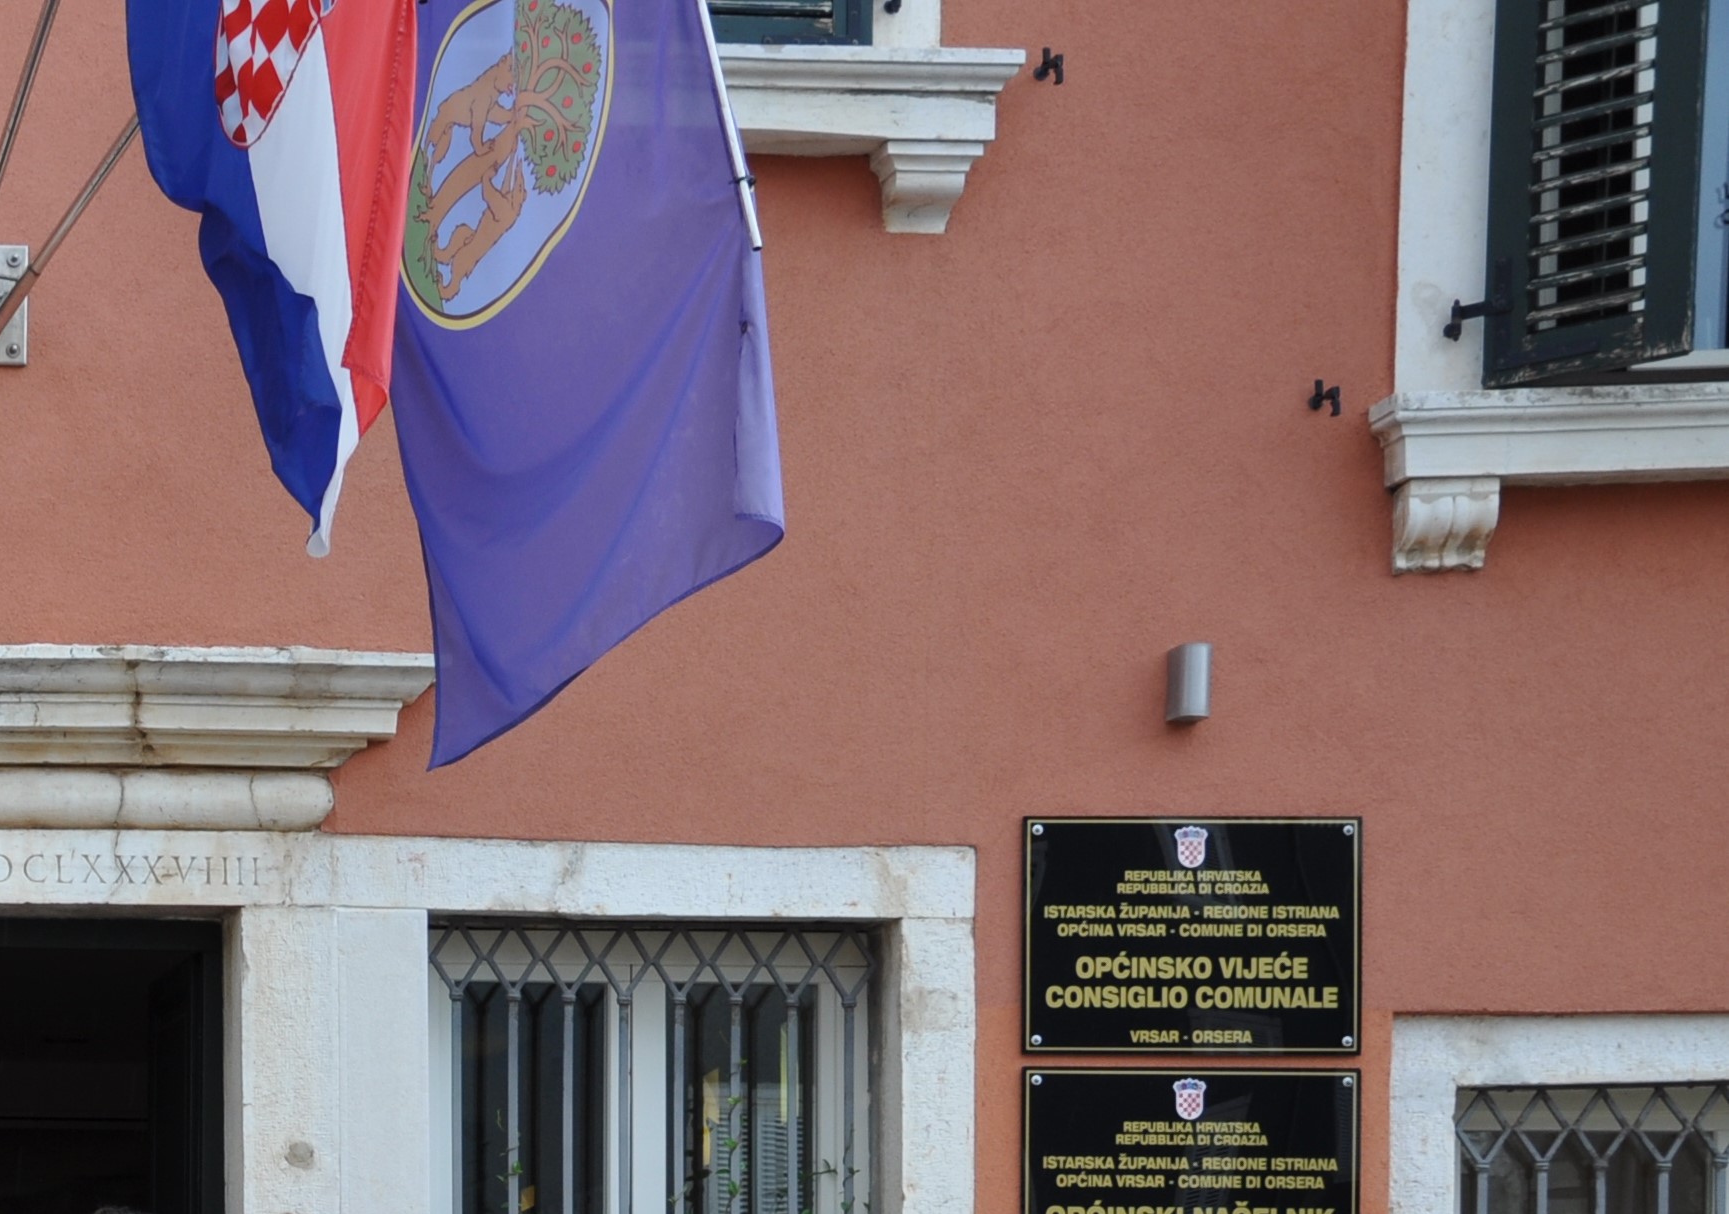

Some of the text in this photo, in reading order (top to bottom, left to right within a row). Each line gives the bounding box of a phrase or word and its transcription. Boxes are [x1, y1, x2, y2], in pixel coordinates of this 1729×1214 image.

[1125, 870, 1262, 882] REPUBLIKA HRVATSKA
[1117, 883, 1269, 895] REPUBBLICA DI CROAZIA
[1044, 905, 1116, 919] ISTARSKA
[1120, 903, 1190, 919] ŽUPANIJA
[1203, 905, 1268, 919] REGIONE
[1273, 905, 1339, 919] ISTRIANA
[1057, 921, 1114, 937] OPĆINA
[1117, 924, 1166, 937] VRSAR
[1179, 924, 1243, 938] COMUNE
[1247, 924, 1262, 937] DI
[1266, 924, 1326, 938] ORSERA
[1076, 951, 1308, 979] OPĆINSKO VIJEĆE
[1045, 986, 1338, 1009] CONSIGLIO COMUNALE
[1130, 1030, 1179, 1043] VRSAR
[1192, 1030, 1252, 1044] ORSERA
[1124, 1121, 1260, 1133] REPUBLIKA HRVATSKA
[1116, 1134, 1268, 1146] REPUBBLICA DI CROAZIA
[1043, 1156, 1114, 1170] ISTARSKA
[1118, 1154, 1189, 1170] ŽUPANIJA
[1202, 1157, 1267, 1171] REGIONE
[1271, 1157, 1338, 1171] ISTRIANA
[1056, 1172, 1112, 1187] OPĆINA
[1116, 1175, 1165, 1188] VRSAR
[1178, 1175, 1241, 1188] COMUNE
[1246, 1175, 1260, 1188] DI
[1265, 1176, 1324, 1189] ORSERA
